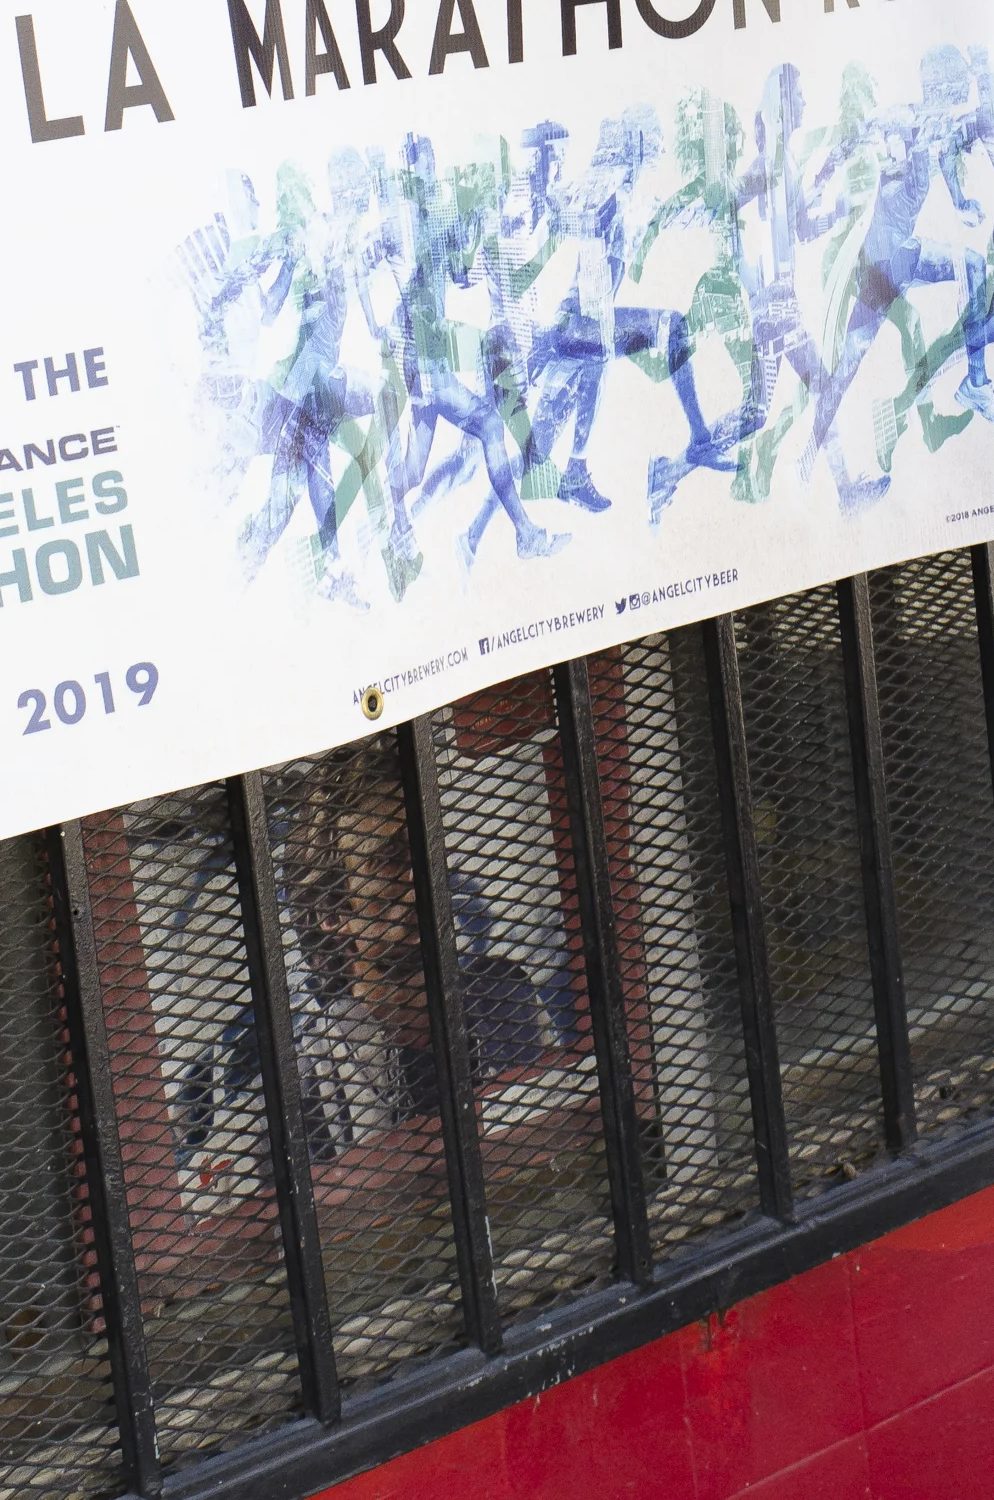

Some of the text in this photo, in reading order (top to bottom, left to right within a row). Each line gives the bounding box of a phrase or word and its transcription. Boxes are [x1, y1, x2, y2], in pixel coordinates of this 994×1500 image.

[15, 0, 175, 143] LA
[14, 347, 108, 401] THE
[642, 568, 739, 605] @ANGELCITYBEER
[17, 662, 158, 736] 2019
